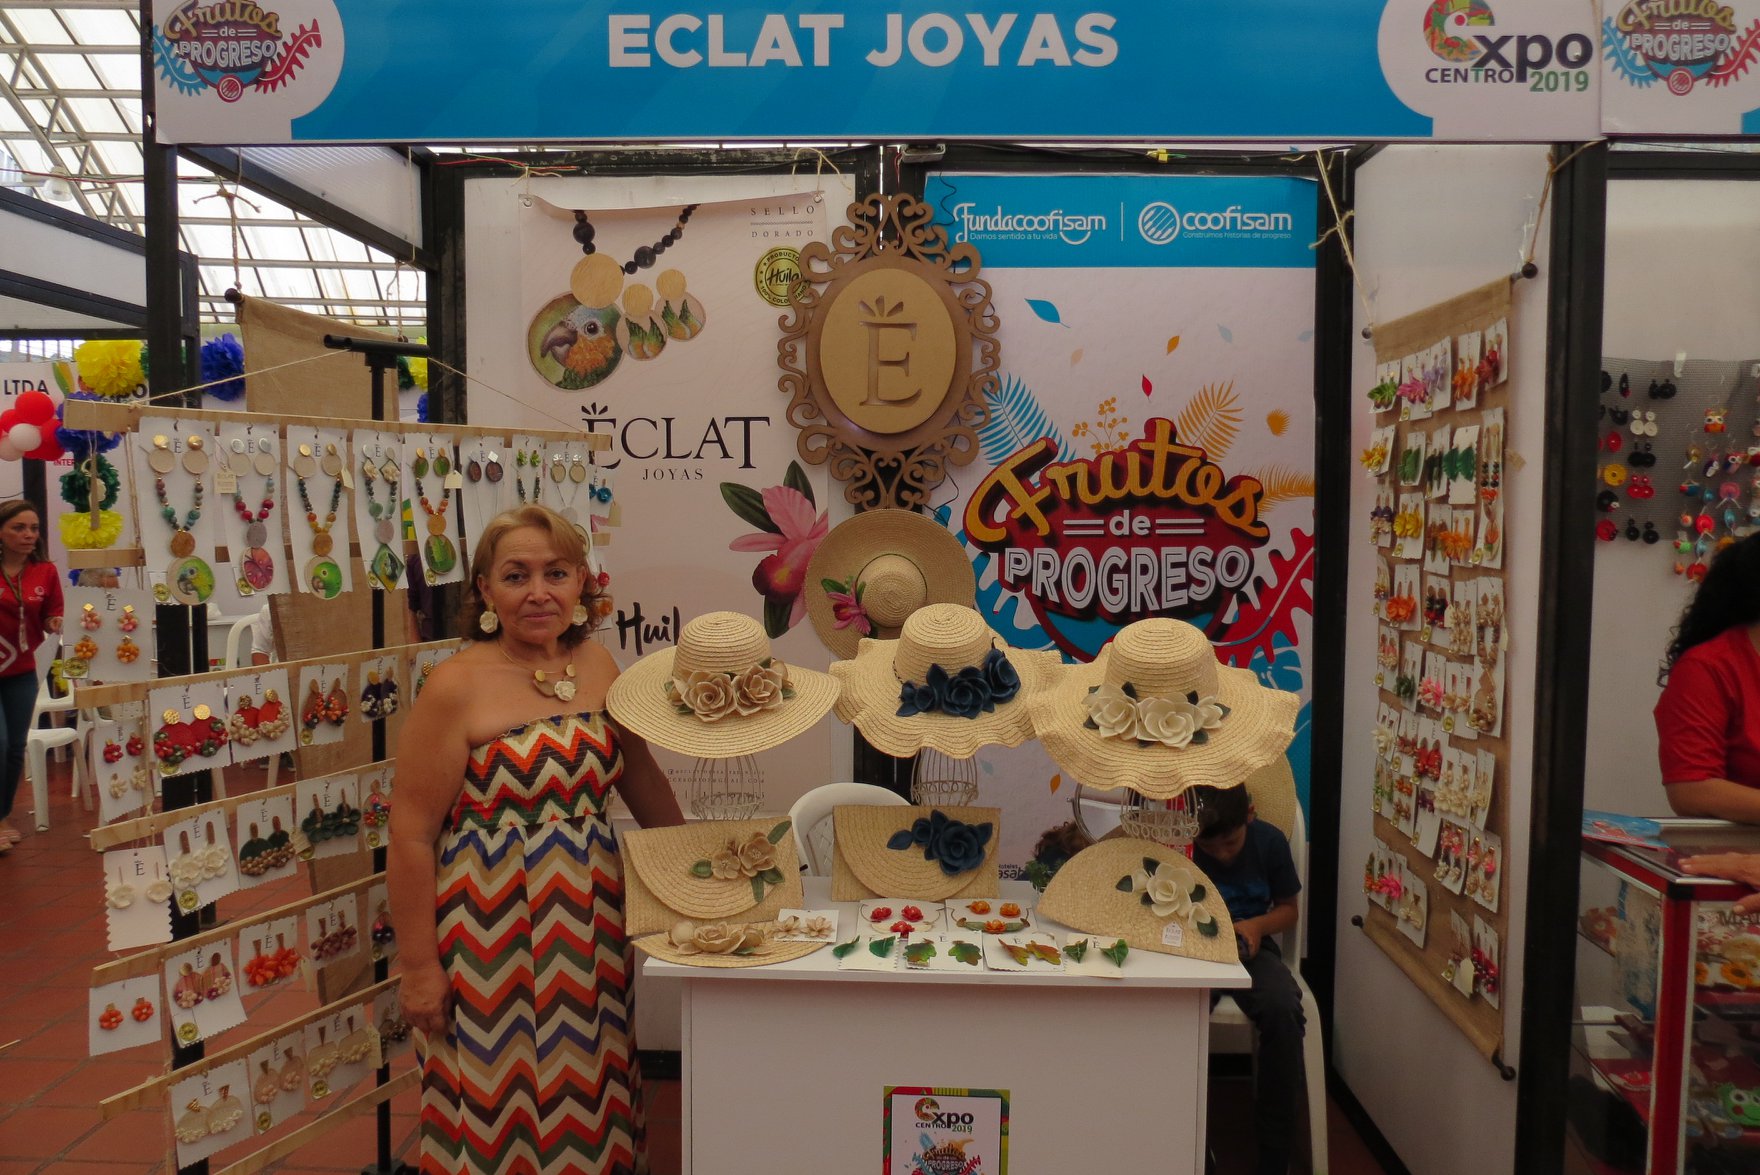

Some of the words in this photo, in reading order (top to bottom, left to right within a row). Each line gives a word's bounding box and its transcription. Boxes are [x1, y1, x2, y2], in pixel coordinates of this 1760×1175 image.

[220, 26, 237, 37] de
[1672, 20, 1690, 30] de
[609, 13, 844, 68] ECLAT
[865, 13, 1118, 68] JOYAS
[1631, 33, 1731, 61] PROGRESO
[179, 40, 276, 68] PROGRESO
[1425, 68, 1515, 83] CENTRO
[1530, 71, 1589, 92] 2019
[750, 205, 815, 216] SELLO
[1182, 206, 1292, 231] coofisam
[751, 230, 813, 238] DORADO
[953, 203, 1106, 243] Fundacoofisam
[970, 232, 996, 240] Damos
[998, 232, 1025, 240] sentido
[1042, 232, 1057, 240] vida
[858, 320, 922, 408] E
[4, 380, 49, 395] LTDA
[581, 415, 770, 470] ECLAT
[642, 468, 704, 481] JOYAS
[965, 418, 1269, 543] Frutos
[1109, 509, 1151, 536] de
[1004, 545, 1251, 613] PROGRESO
[135, 863, 145, 876] E
[951, 1124, 973, 1133] 2019
